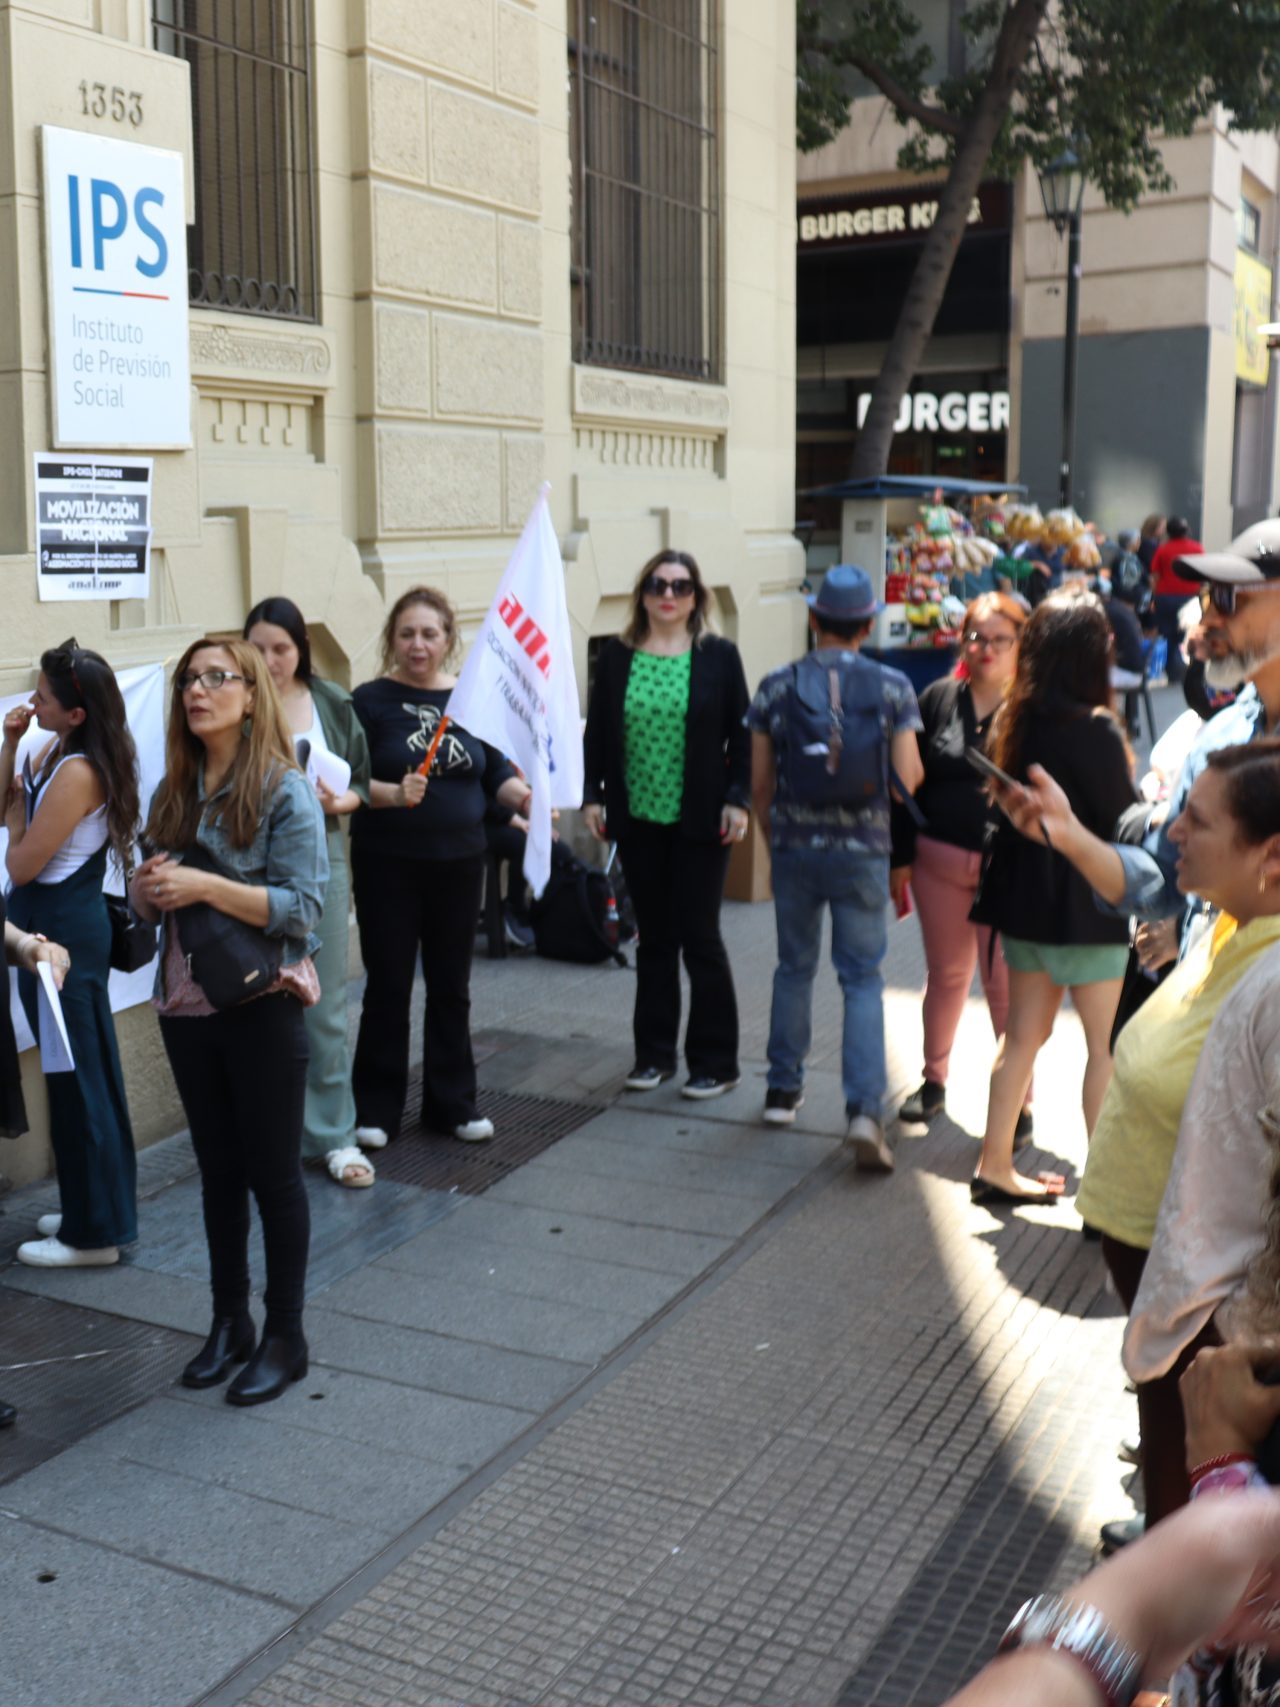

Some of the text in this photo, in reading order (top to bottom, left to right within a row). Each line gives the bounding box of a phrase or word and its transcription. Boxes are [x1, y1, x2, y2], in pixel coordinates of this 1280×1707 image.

[78, 79, 144, 126] 1353
[67, 173, 169, 279] IPS
[800, 204, 906, 241] BURGER
[72, 313, 144, 345] Instituto
[73, 349, 172, 379] de Previsión
[74, 380, 125, 408] Social
[61, 520, 128, 541] NACIONAL
